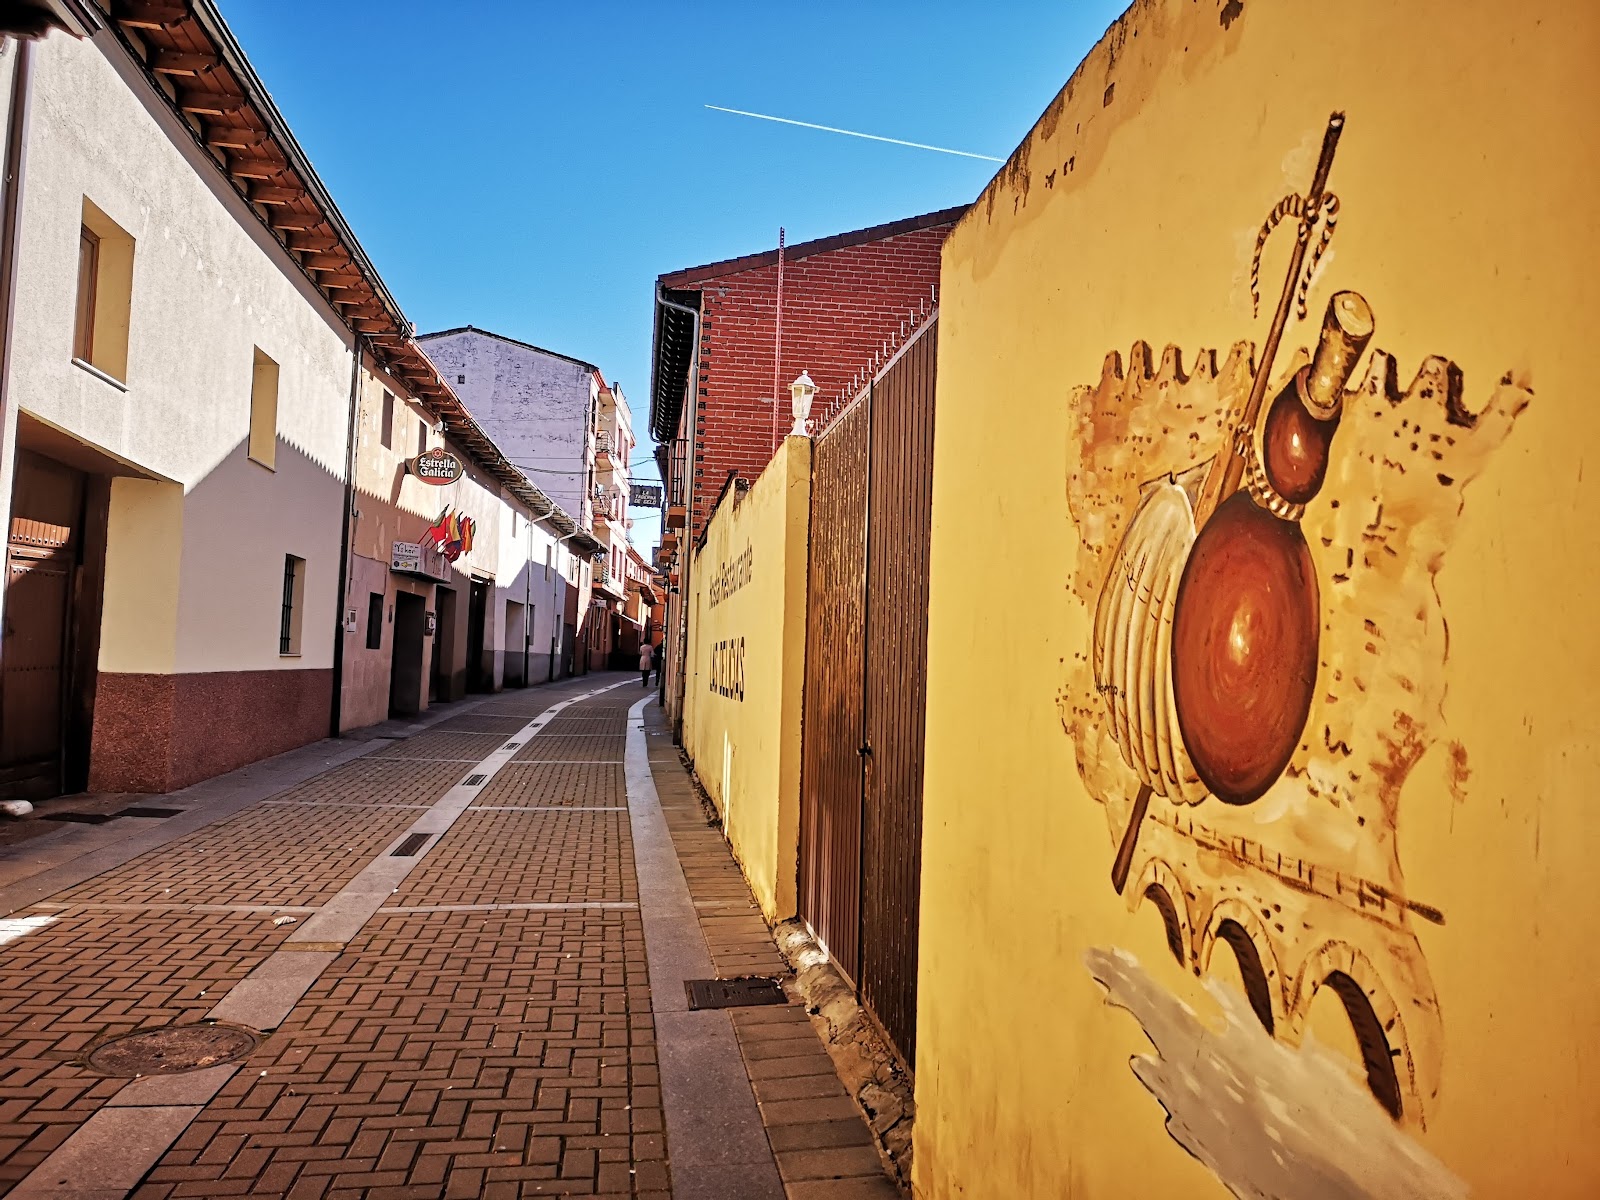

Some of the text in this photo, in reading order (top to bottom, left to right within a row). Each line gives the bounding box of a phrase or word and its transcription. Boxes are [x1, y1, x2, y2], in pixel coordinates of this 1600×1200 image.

[419, 457, 456, 469] Estrella
[420, 467, 454, 478] Galicia
[722, 536, 752, 600] Restaurante
